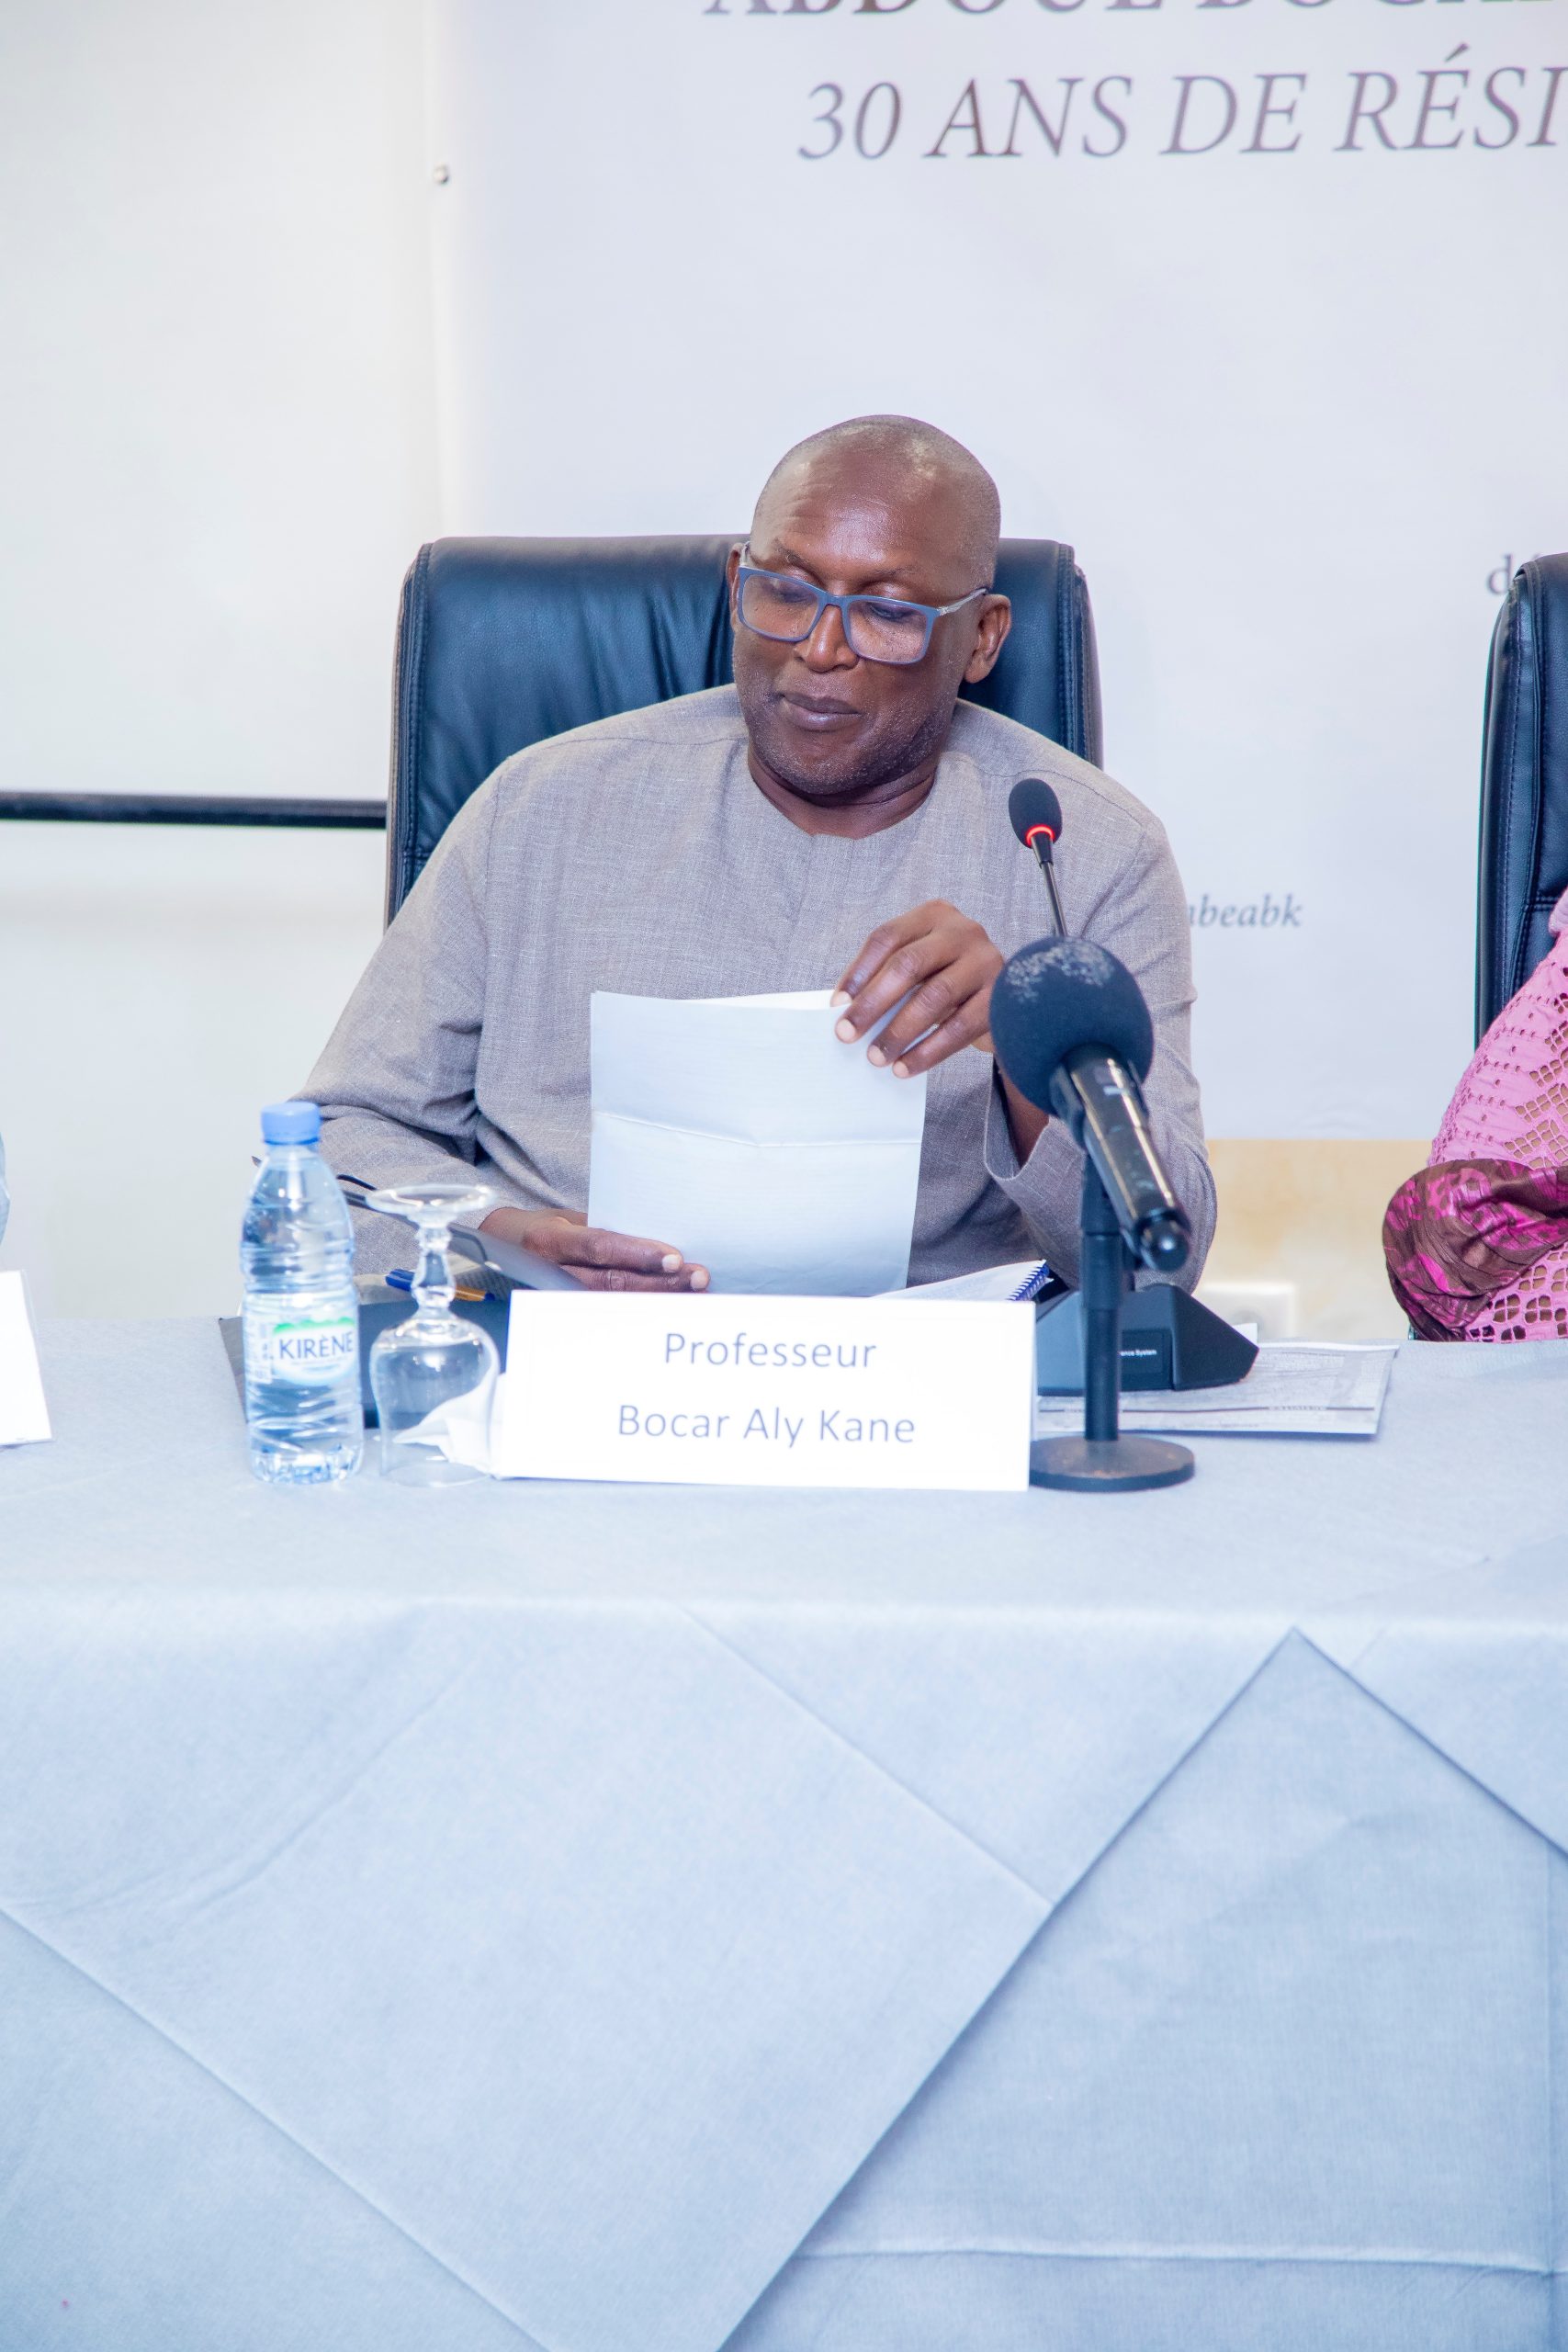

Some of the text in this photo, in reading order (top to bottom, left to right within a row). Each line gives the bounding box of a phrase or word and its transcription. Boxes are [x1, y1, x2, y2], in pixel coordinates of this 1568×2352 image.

[797, 41, 1568, 160] 30 ANS DE RÉSI
[278, 1331, 354, 1360] KIRÈNE
[663, 1331, 877, 1368] Professeur
[617, 1403, 916, 1448] Bocar Aly Kane
